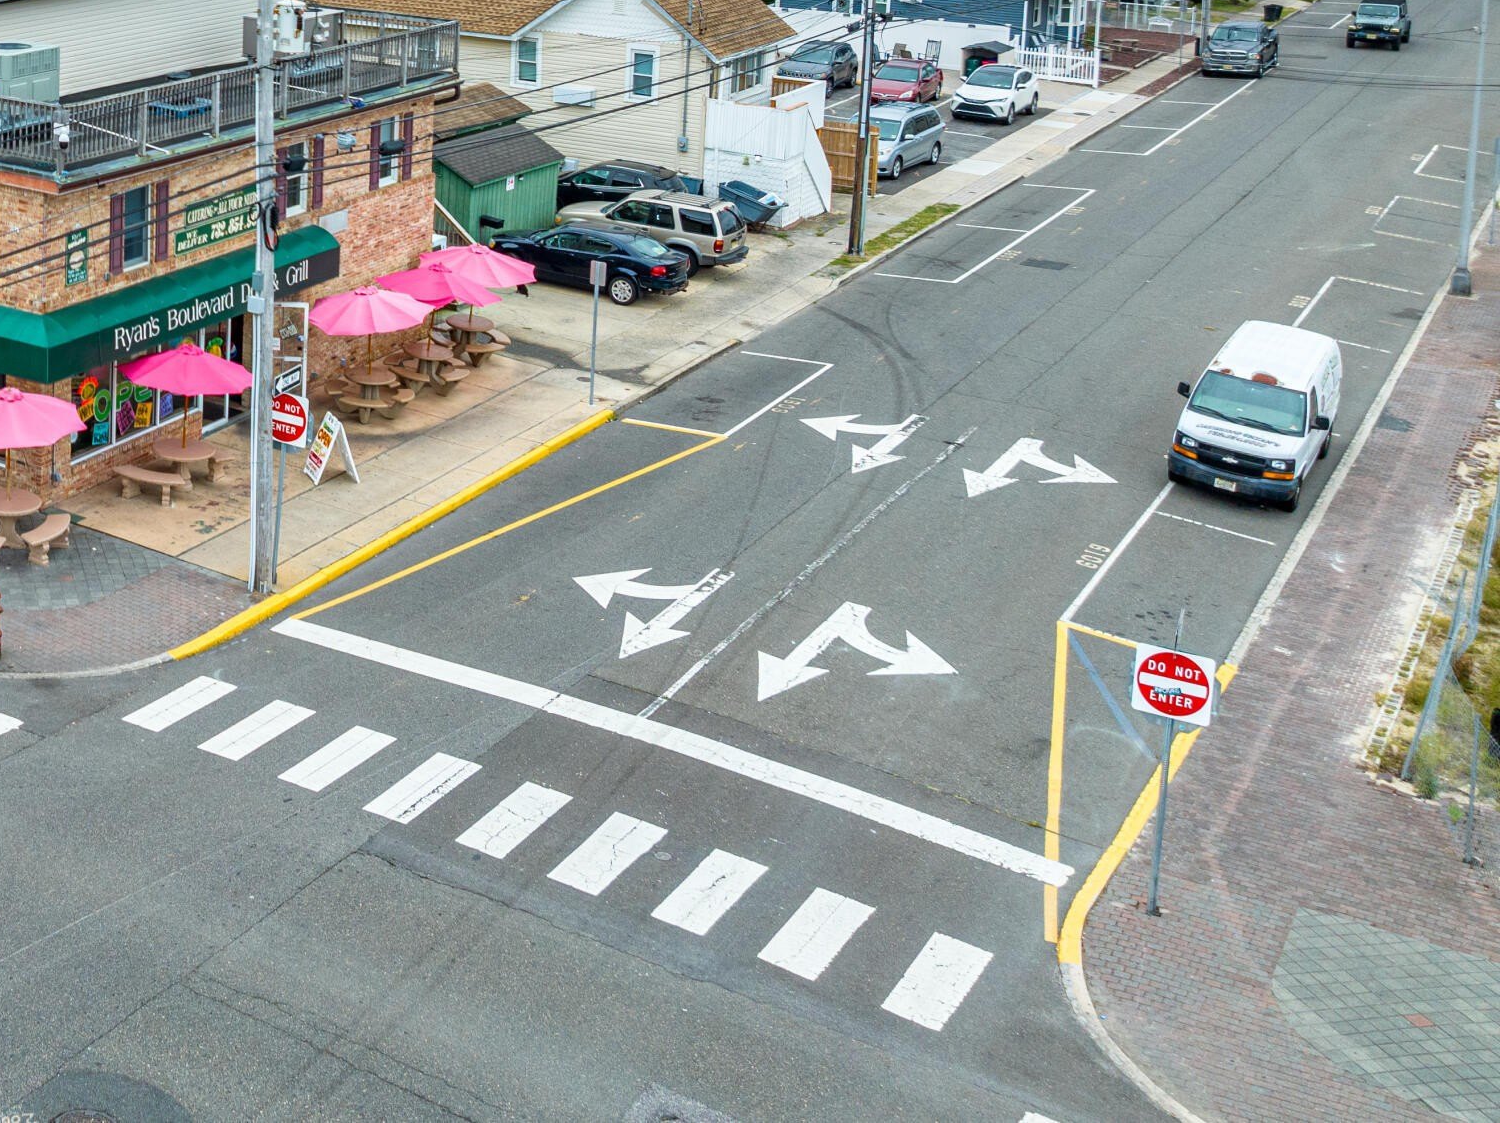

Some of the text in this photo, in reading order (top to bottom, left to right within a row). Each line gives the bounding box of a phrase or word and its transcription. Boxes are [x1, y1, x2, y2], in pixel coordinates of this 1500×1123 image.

[177, 233, 208, 252] DELIVER
[186, 229, 198, 239] WE
[114, 315, 161, 350] Ryan's
[167, 288, 234, 331] Boulevard
[285, 259, 309, 286] Grill
[284, 402, 301, 415] NOT
[272, 421, 297, 435] ENTER
[316, 428, 332, 450] OPEN
[1147, 659, 1201, 681] DO NOT
[1149, 689, 1193, 709] ENTER
